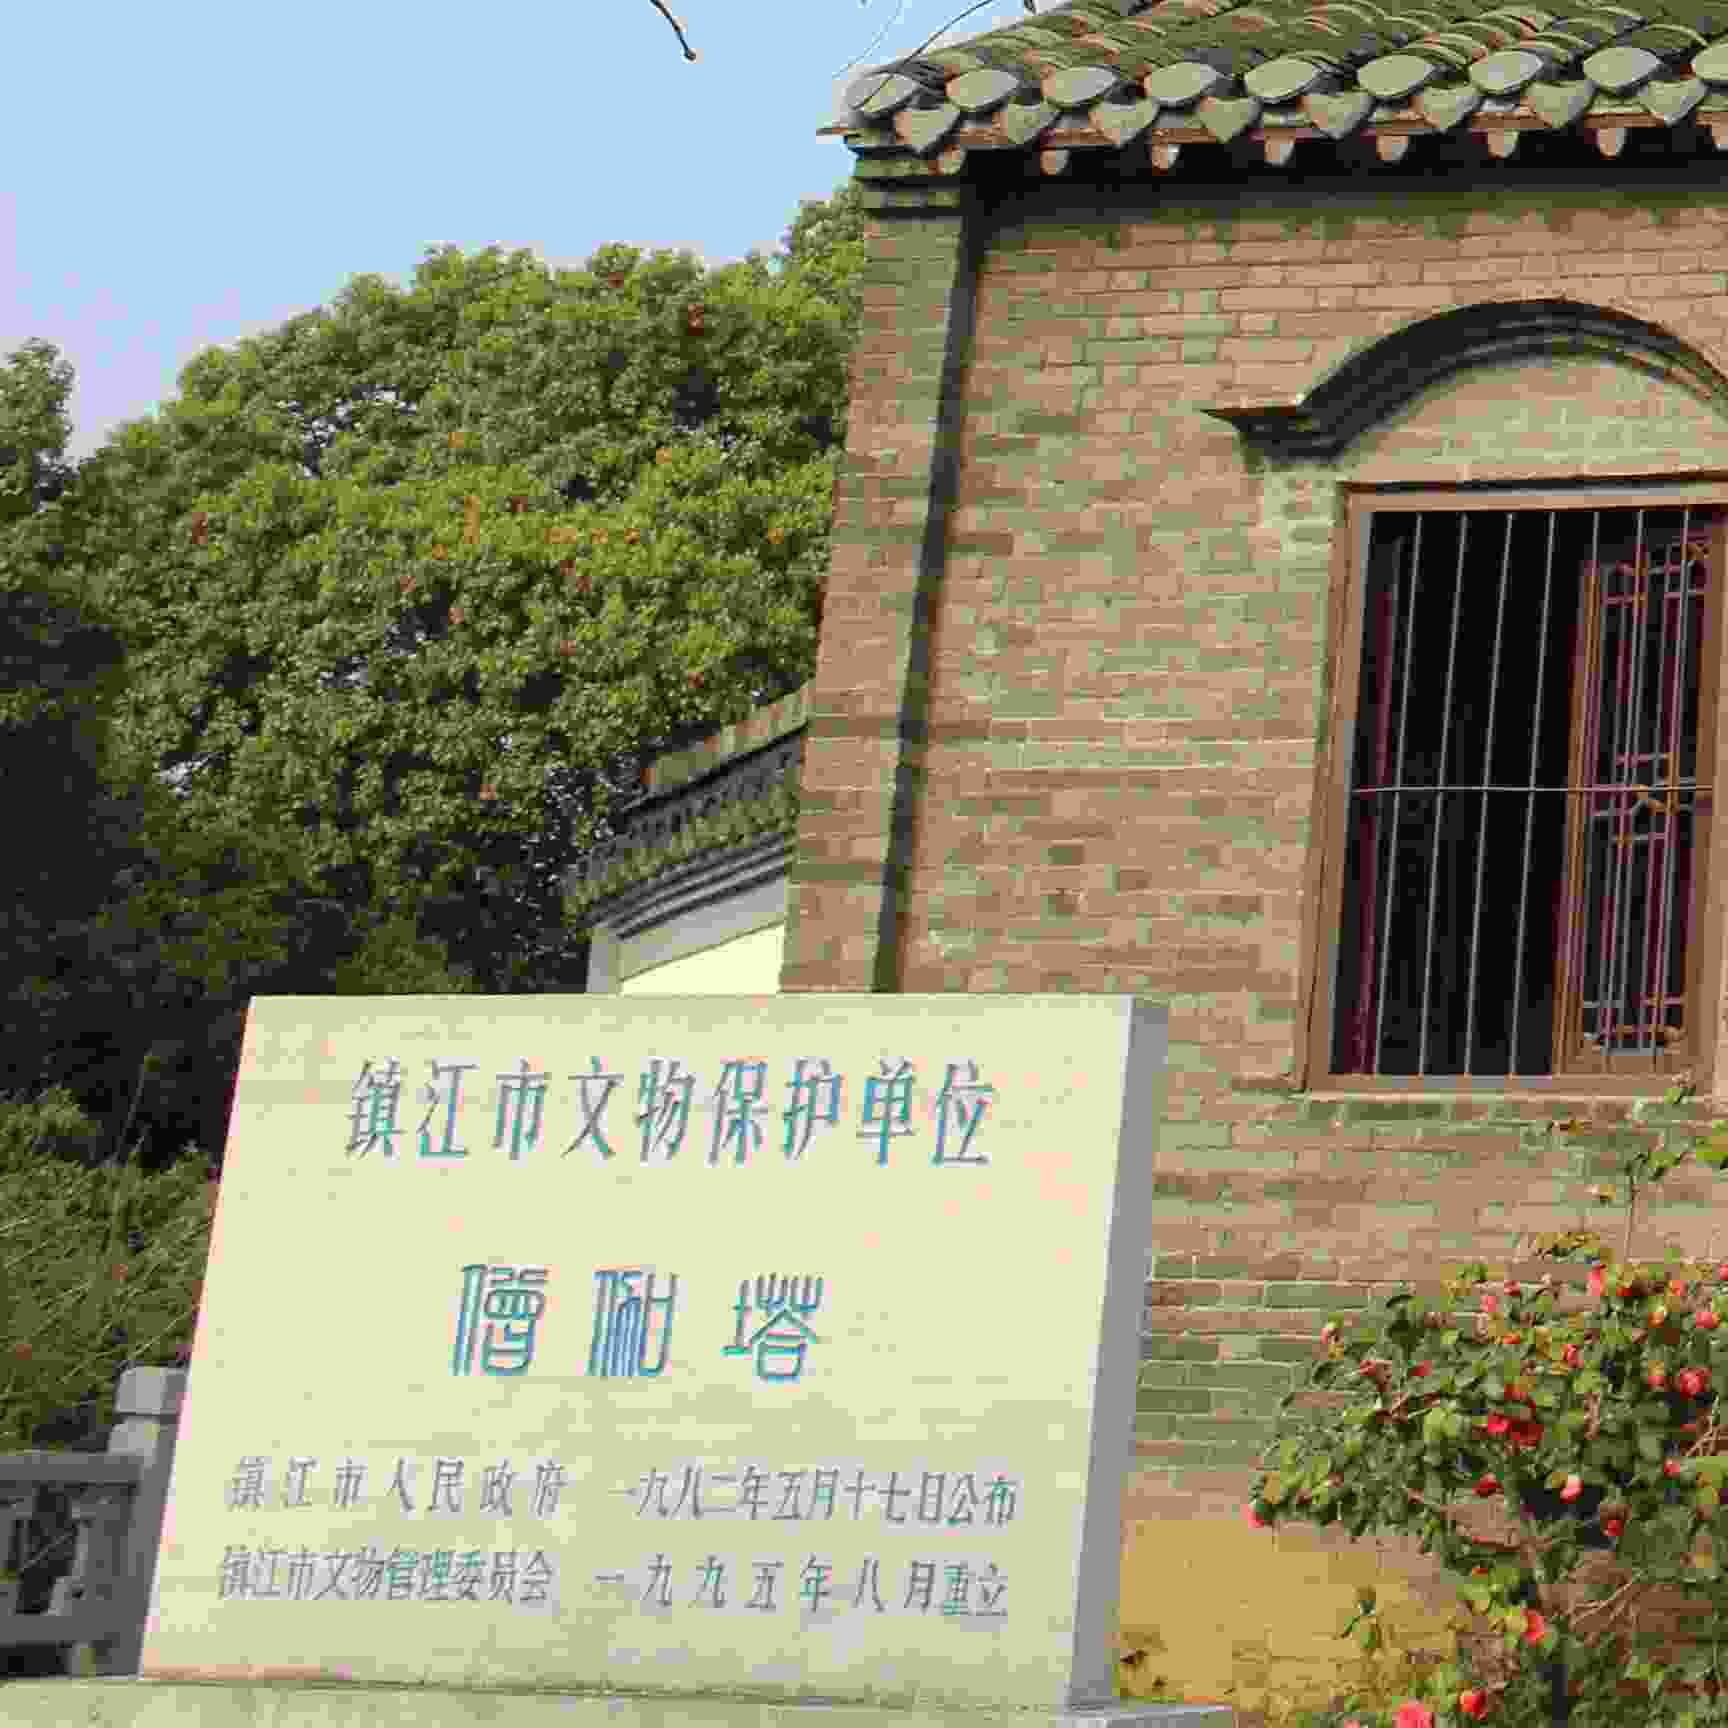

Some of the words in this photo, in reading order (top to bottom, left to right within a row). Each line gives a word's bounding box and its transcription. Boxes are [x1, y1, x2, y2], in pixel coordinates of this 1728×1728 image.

[345, 1056, 997, 1167] 镇江市文物保护单位
[448, 1263, 824, 1384] 僧伽塔
[225, 1456, 568, 1518] 镇江市人民政府
[607, 1464, 1021, 1527] 一九八二年五月十七日公布
[218, 1542, 554, 1604] 镇江市文物管理委员会
[594, 1552, 1009, 1618] 一九九五年八月重立
